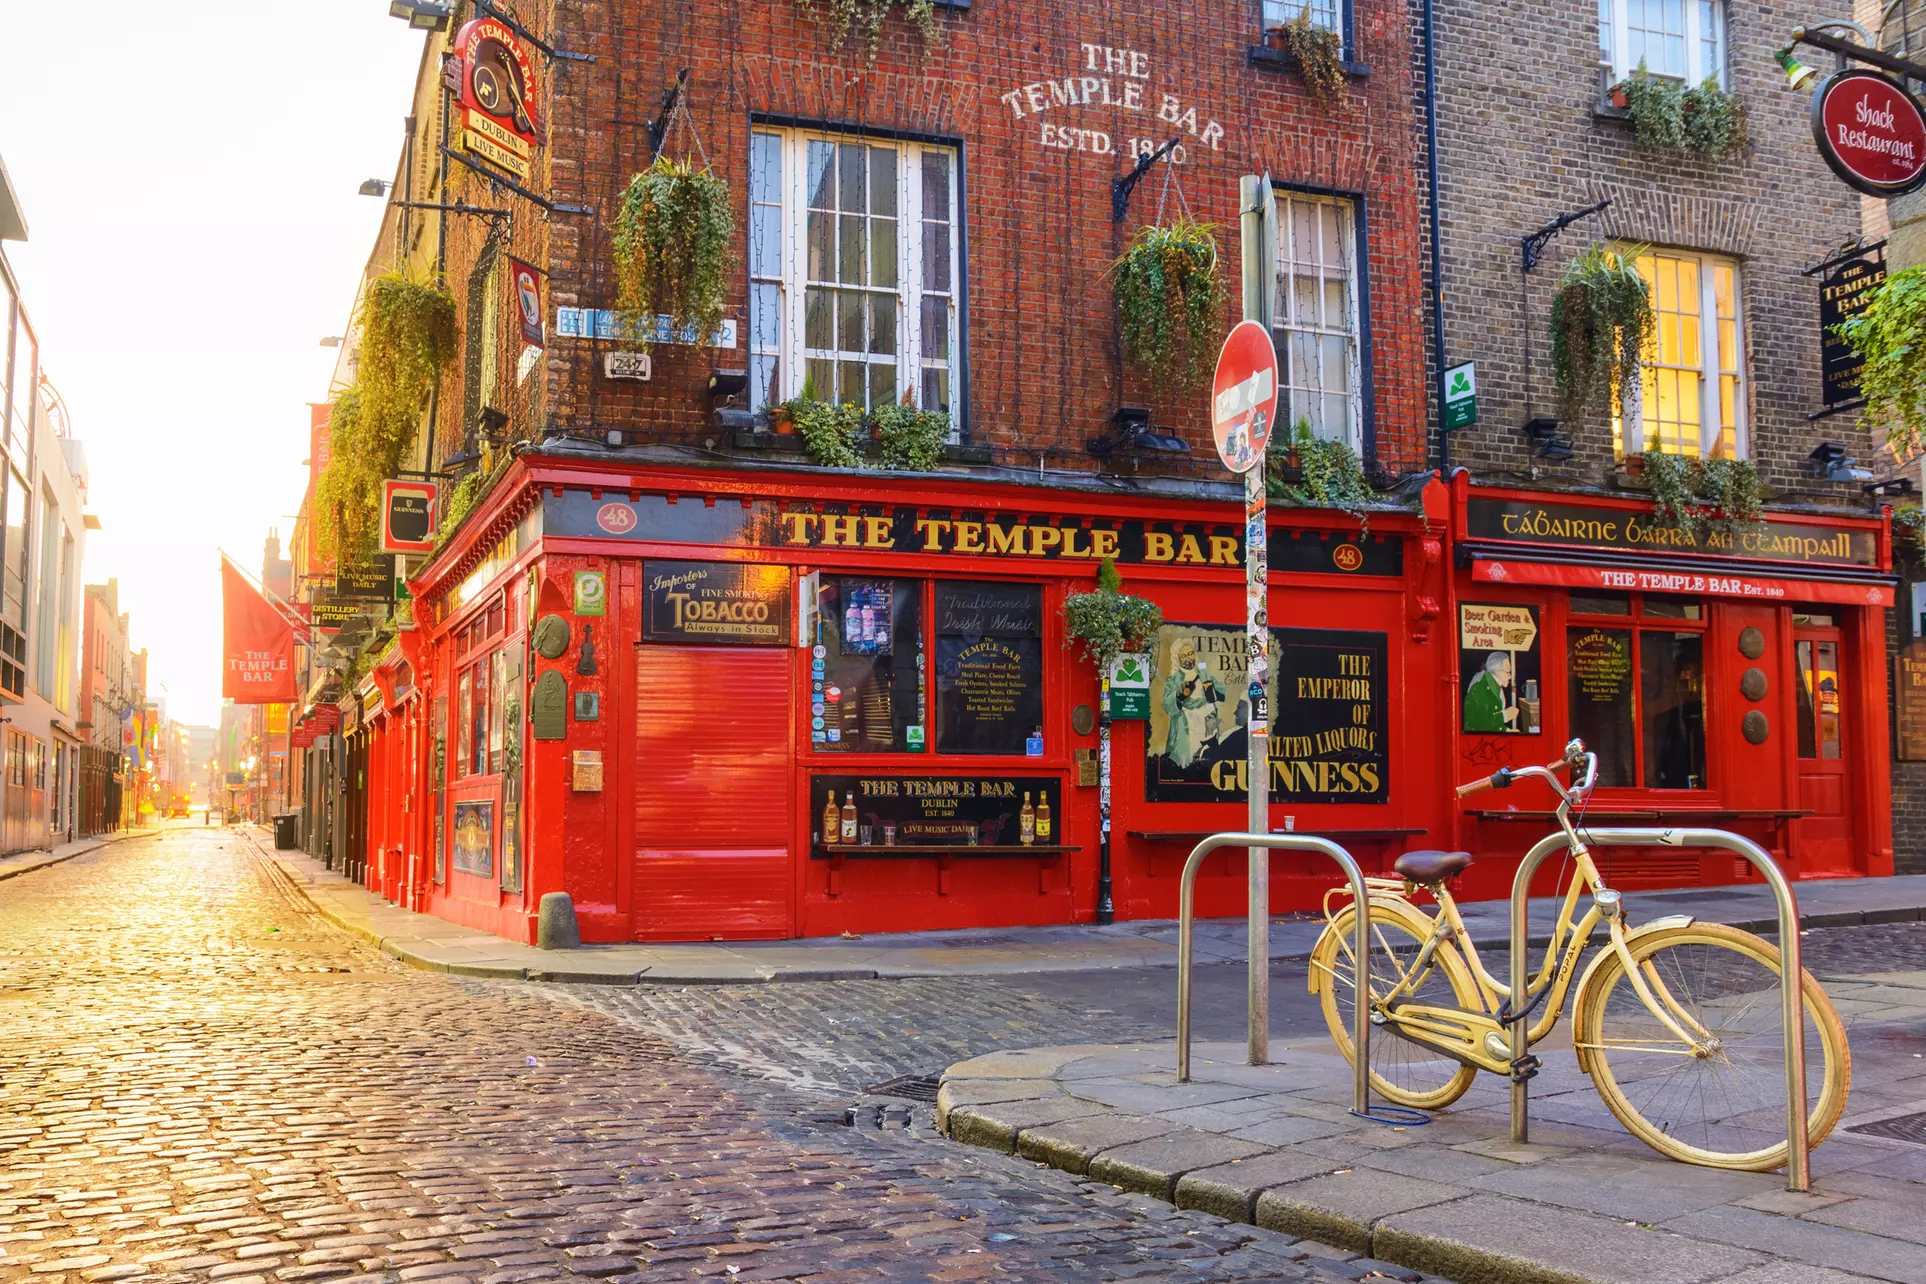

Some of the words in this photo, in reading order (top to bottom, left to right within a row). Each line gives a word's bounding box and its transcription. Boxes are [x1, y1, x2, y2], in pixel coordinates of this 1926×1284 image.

[467, 32, 481, 65] THE
[478, 24, 522, 62] TEMPLE
[521, 65, 532, 102] BAR
[1081, 42, 1149, 79] THE
[1000, 77, 1143, 120] TEMPLE
[1157, 94, 1225, 151] BAR
[1856, 94, 1896, 132] Shack
[482, 119, 518, 148] DUBLIN
[1040, 122, 1117, 155] ESTD.
[1837, 124, 1916, 159] Restaurant
[474, 137, 494, 156] LIVE
[497, 151, 525, 173] MUSIC
[1842, 265, 1864, 279] THE
[1823, 270, 1885, 301] TEMPLE
[1829, 369, 1850, 382] LIVE
[394, 506, 424, 514] GUINNESS
[604, 507, 628, 526] 48
[781, 512, 896, 549] THE
[915, 519, 1121, 559] TEMPLE
[1143, 531, 1240, 566] BAR
[1337, 549, 1356, 565] 48
[649, 569, 708, 592] Importers
[1600, 571, 1636, 587] THE
[1639, 574, 1704, 592] TEMPLE
[1708, 578, 1742, 594] BAR
[1766, 588, 1785, 597] 1840
[701, 588, 723, 598] FINE
[724, 589, 768, 601] SMOKING
[945, 592, 1031, 609] Traditional
[312, 605, 359, 613] DISTILLERY
[665, 593, 769, 628] TOBACCO
[1464, 608, 1485, 621] Beer
[1488, 610, 1521, 623] Garden
[686, 622, 726, 632] Always
[732, 624, 741, 632] in
[746, 625, 777, 634] Stock
[943, 612, 982, 629] Irish
[991, 614, 1036, 631] Music
[1464, 622, 1503, 637] Smoking
[1193, 636, 1277, 657] TEME
[1472, 636, 1494, 647] Area
[1575, 634, 1605, 649] TEMPLE
[1606, 637, 1622, 652] BAR
[246, 651, 270, 660] THE
[958, 643, 999, 660] TEMPLE
[1002, 646, 1021, 663] BAR
[229, 659, 288, 671] TEMPLE
[1338, 655, 1371, 676] THE
[243, 672, 274, 682] BAR
[1297, 677, 1371, 701] EMPEROR
[1352, 704, 1371, 725] OF
[1267, 736, 1312, 758] ALTED
[1315, 726, 1378, 754] LIQUORS
[1211, 759, 1380, 793] GUNNESS
[860, 780, 899, 797] THE
[903, 781, 976, 798] TEMPLE
[980, 781, 1016, 798] BAR
[921, 799, 959, 808] DUBLIN
[903, 824, 923, 835] LIVE
[924, 825, 950, 834] MUSIC
